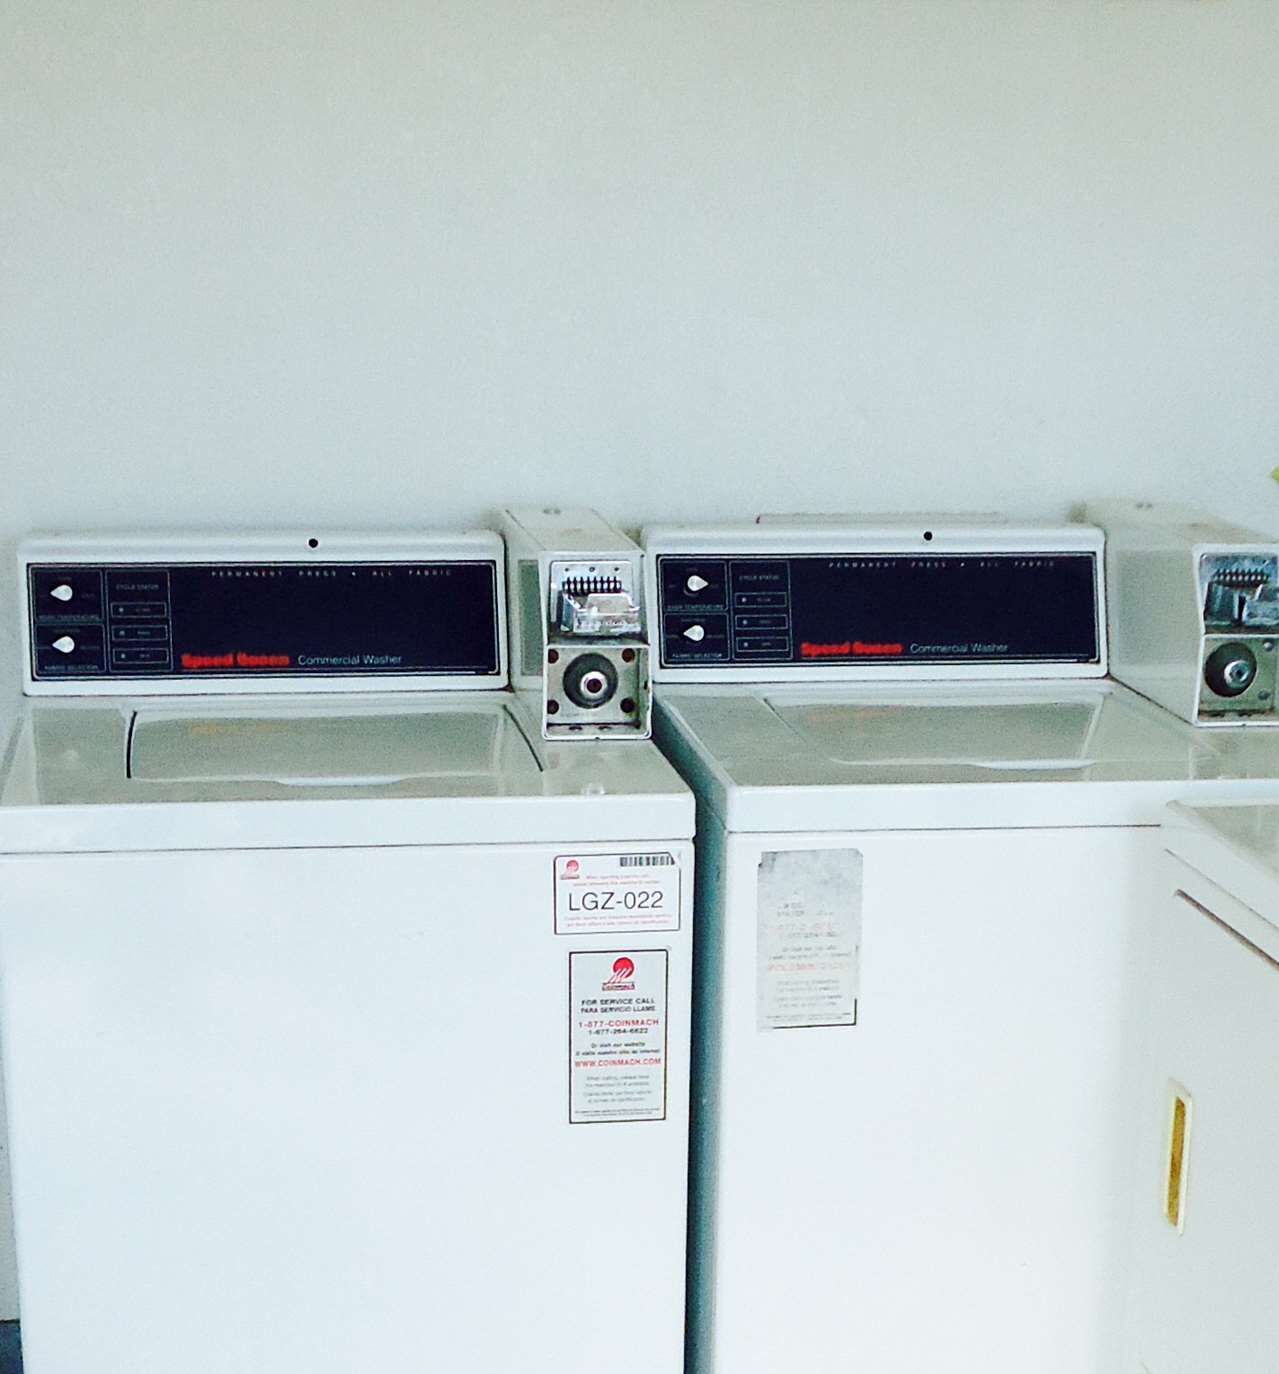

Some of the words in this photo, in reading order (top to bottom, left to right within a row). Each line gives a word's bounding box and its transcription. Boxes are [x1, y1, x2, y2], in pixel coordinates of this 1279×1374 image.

[910, 643, 968, 654] Commercial
[971, 643, 1008, 653] Washer
[298, 654, 360, 665] Commercial
[363, 654, 402, 665] Washer
[569, 890, 664, 911] LGZ-022
[600, 998, 633, 1006] SERVICE
